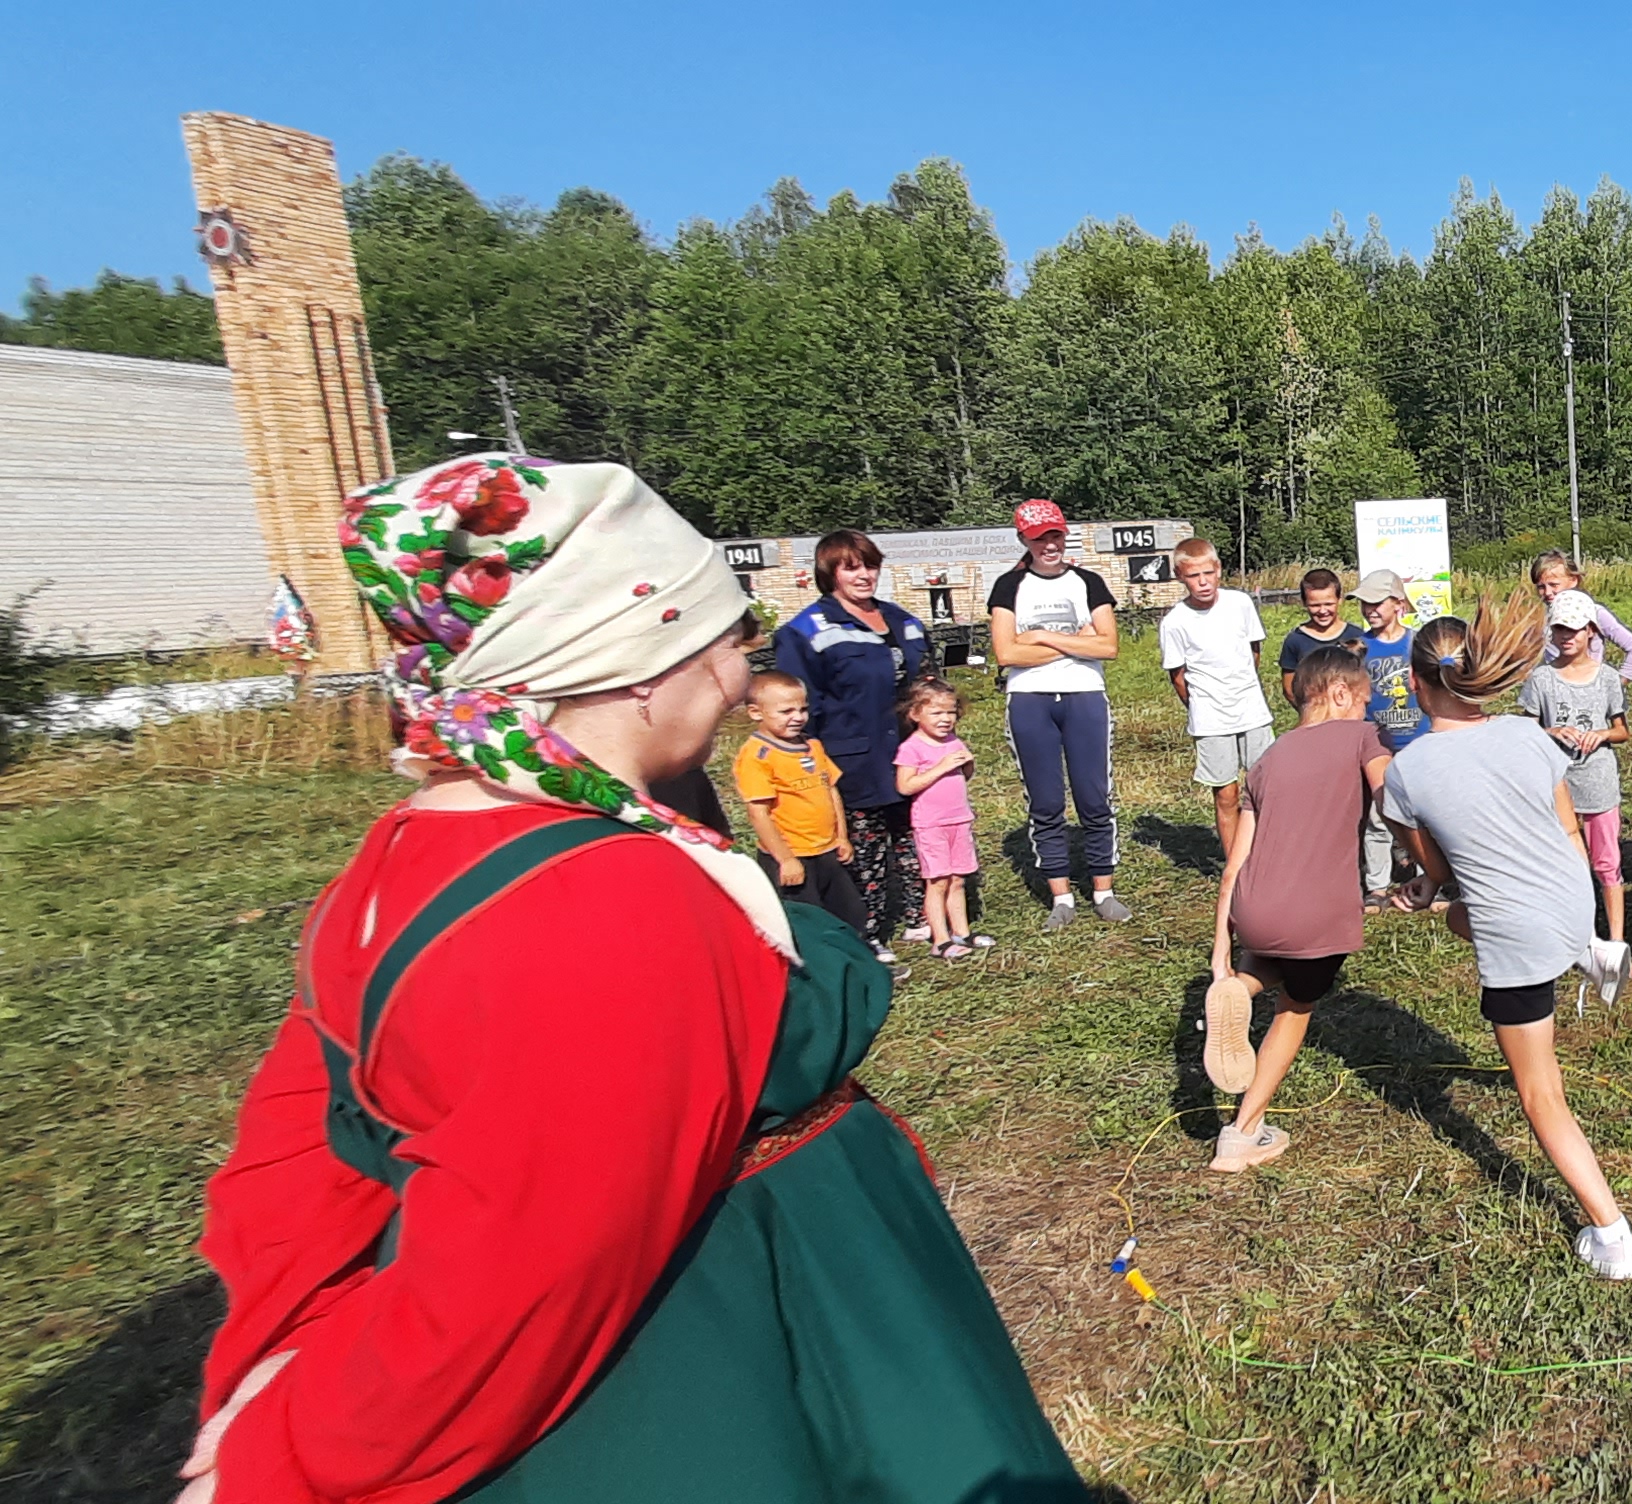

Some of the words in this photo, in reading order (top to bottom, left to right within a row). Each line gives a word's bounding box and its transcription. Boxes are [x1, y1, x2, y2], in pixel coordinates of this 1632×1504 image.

[1377, 515, 1443, 527] СЕЛЬСКИЕ
[1377, 526, 1444, 535] КАНИКУЛЫ
[932, 536, 973, 547] ПАВШИМ
[974, 535, 980, 545] В
[983, 534, 1007, 545] БОЯХ
[1114, 530, 1154, 548] 1945
[726, 548, 761, 565] 1941
[956, 545, 988, 557] НАШЕЙ
